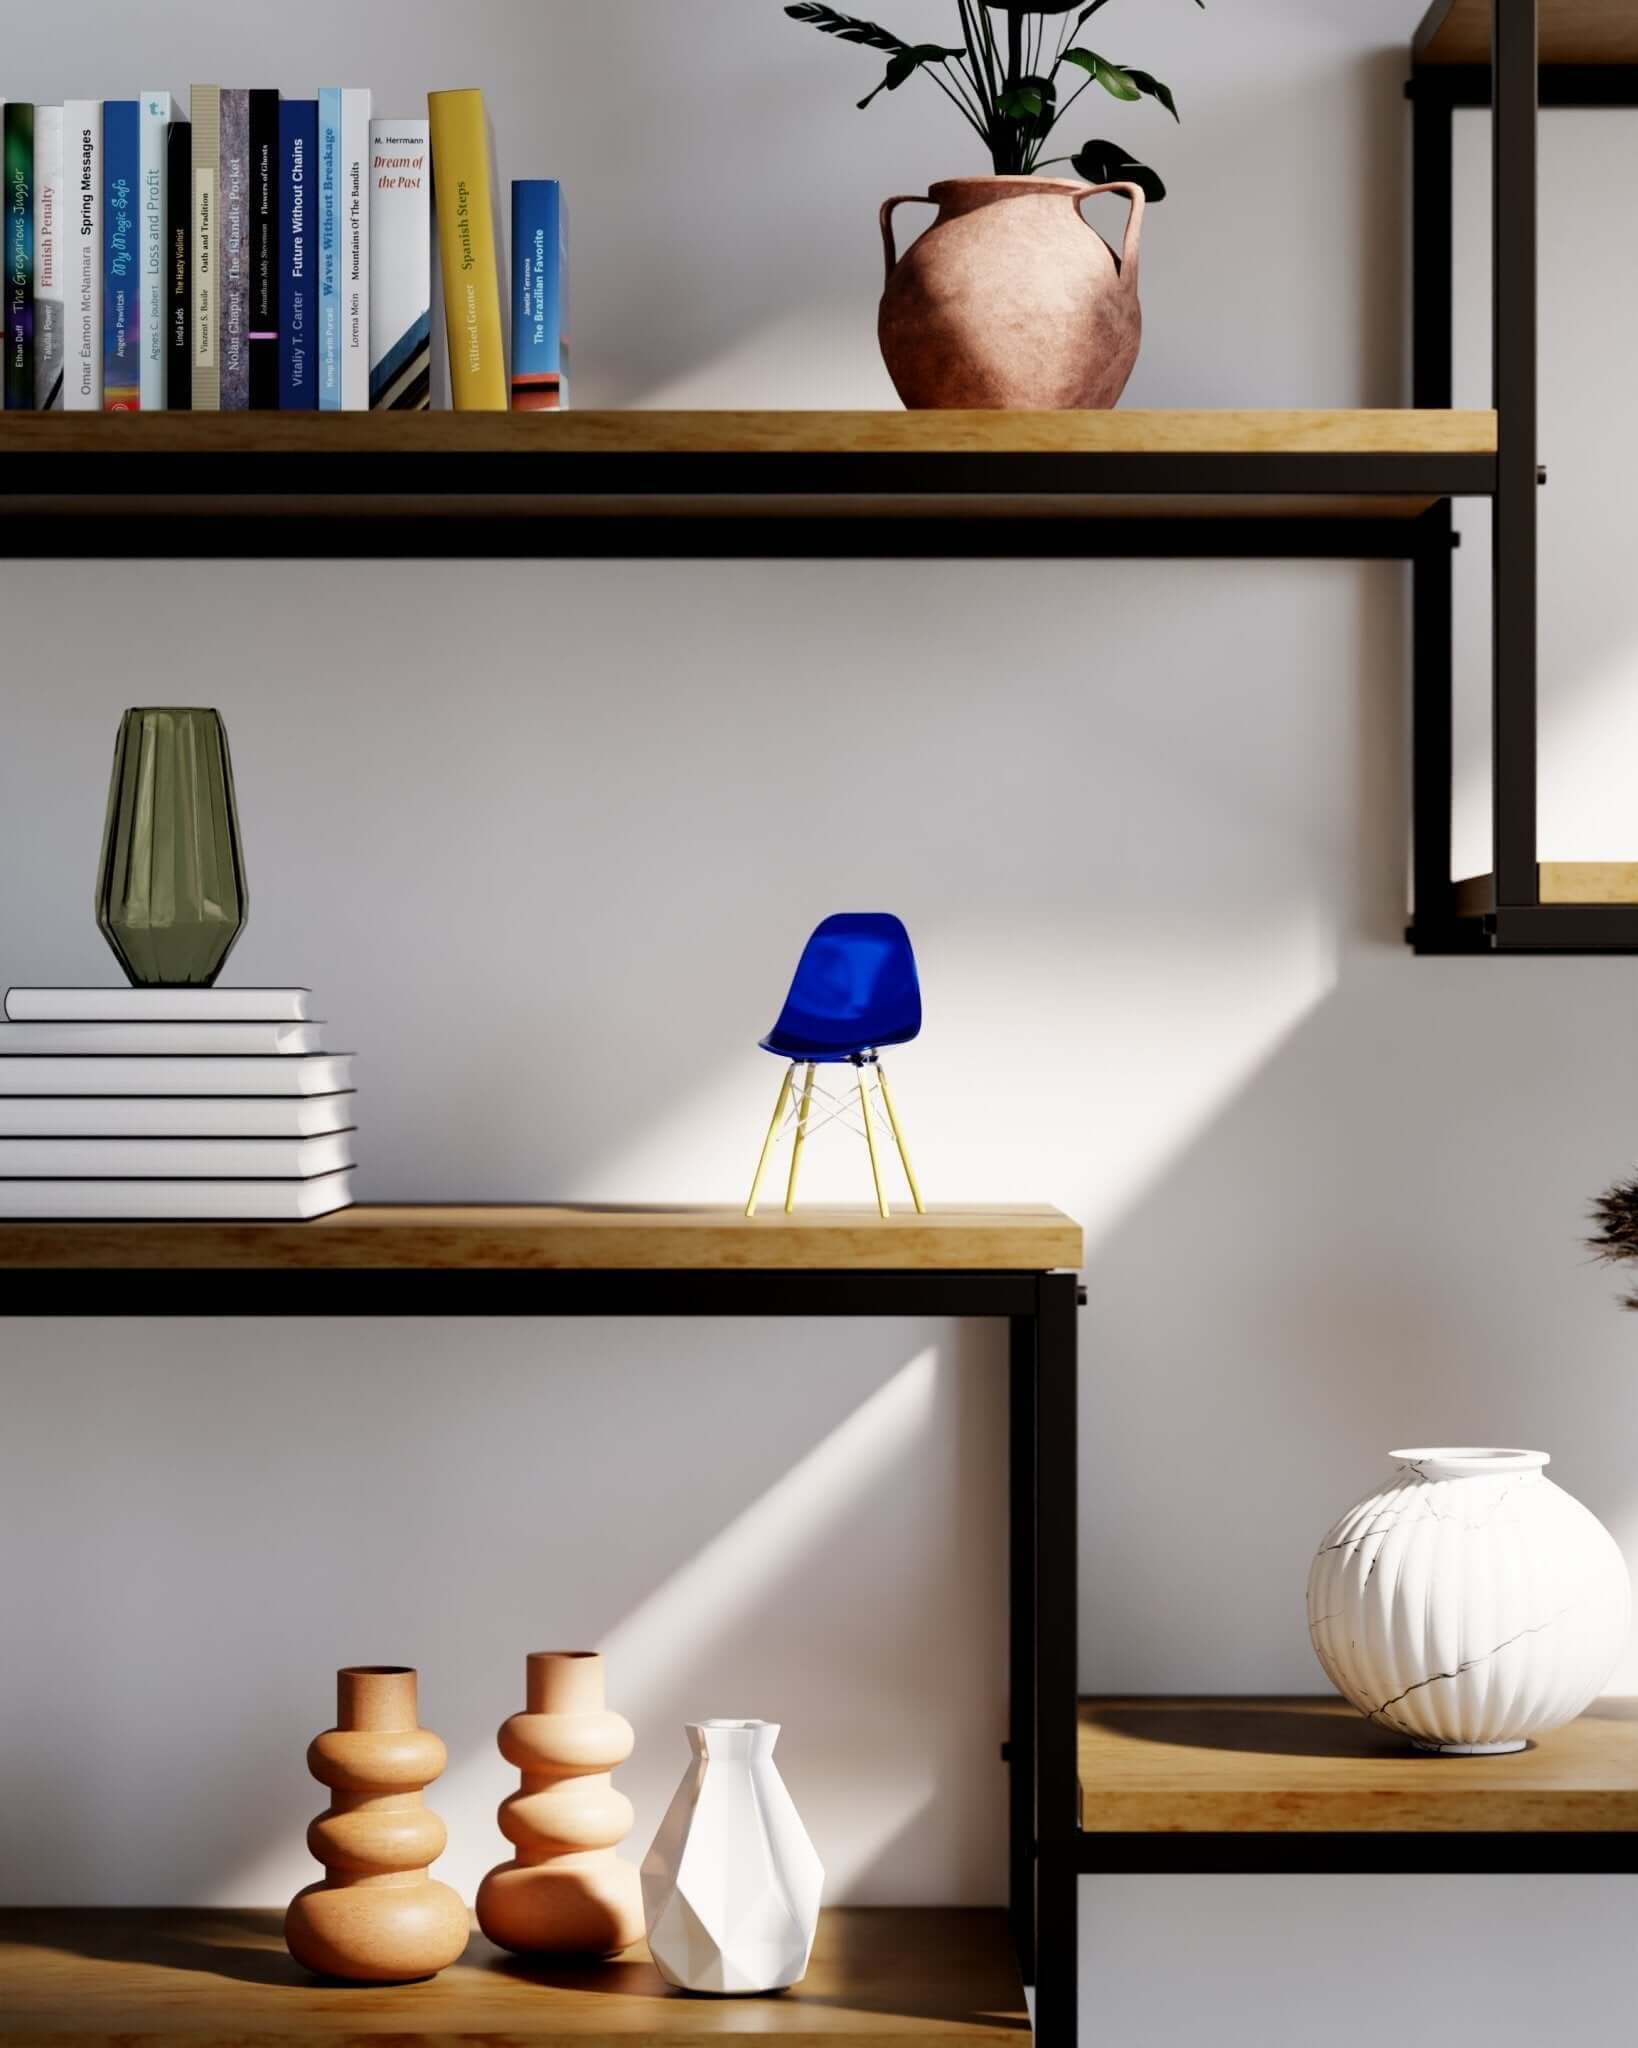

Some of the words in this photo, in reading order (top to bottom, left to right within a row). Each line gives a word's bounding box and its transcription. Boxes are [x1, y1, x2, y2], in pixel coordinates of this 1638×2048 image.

[80, 129, 94, 191] Messages
[260, 144, 268, 172] Ghosts
[292, 138, 303, 182] Chains
[323, 128, 336, 191] Breakage
[374, 156, 410, 168] Dream
[412, 155, 423, 170] of
[12, 168, 28, 214] Juggler
[146, 169, 160, 210] Profit
[229, 158, 240, 200] Pocket
[260, 173, 268, 181] of
[350, 161, 359, 197] Bandits
[378, 175, 395, 188] the
[397, 176, 421, 189] Past
[41, 186, 55, 235] Penalty
[110, 179, 128, 209] Sofa
[260, 183, 268, 214] Flowers
[292, 185, 303, 233] Without
[350, 199, 359, 217] The
[455, 181, 469, 216] Steps
[80, 195, 94, 235] Spring
[147, 215, 160, 240] and
[201, 193, 209, 232] Tradition
[229, 204, 240, 254] Islandic
[323, 195, 334, 249] Without
[350, 218, 359, 229] Of
[110, 211, 132, 250] Magic
[176, 229, 184, 258] Violinist
[201, 235, 209, 249] and
[457, 219, 474, 271] Spanish
[12, 218, 28, 285] Gregarious
[41, 240, 52, 288] Finnish
[111, 252, 132, 276] My
[147, 244, 160, 274] Loss
[201, 252, 209, 273] Oath
[292, 237, 303, 277] Future
[350, 231, 359, 280] Mountains
[534, 229, 544, 273] Favorite
[81, 246, 91, 312] McNamara
[176, 260, 185, 280] Hasty
[229, 258, 240, 280] The
[323, 254, 334, 296] Waves
[13, 288, 24, 314] The
[176, 281, 184, 294] The
[534, 276, 544, 321] Brazilian
[176, 308, 184, 324] Eads
[228, 292, 242, 334] Chaput
[292, 291, 303, 330] Carter
[350, 293, 359, 316] Mein
[16, 325, 24, 342] Duff
[78, 315, 91, 358] Éamon
[116, 330, 125, 357] Angela
[150, 333, 160, 360] Agnes
[176, 326, 184, 346] Linda
[200, 323, 208, 353] Vinzent
[292, 334, 303, 345] T.
[350, 318, 359, 348] Lorena
[467, 326, 481, 372] Wilfried
[534, 324, 544, 344] The
[16, 345, 24, 367] Ethan
[228, 337, 239, 370] Nolan
[292, 348, 305, 386] Vitaliy
[81, 362, 91, 395] Omar
